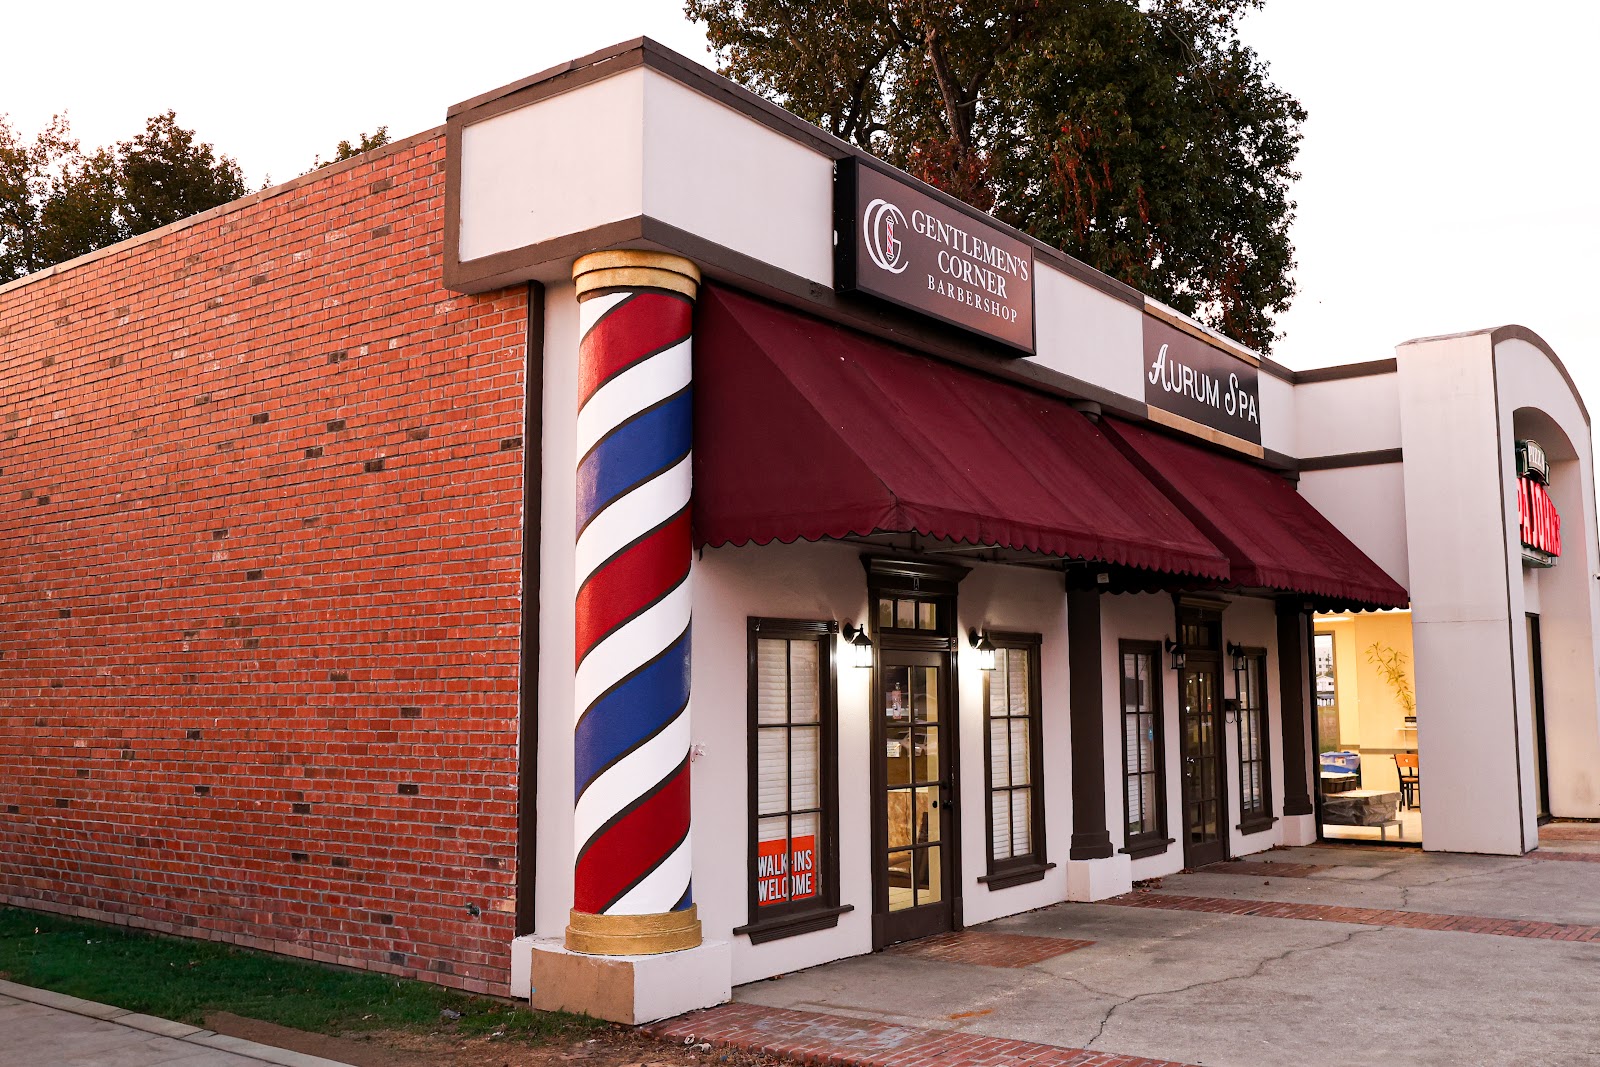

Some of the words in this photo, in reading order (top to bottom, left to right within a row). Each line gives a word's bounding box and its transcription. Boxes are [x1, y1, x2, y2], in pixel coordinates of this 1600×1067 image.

[911, 209, 1029, 281] GENTLEMEN'S
[937, 250, 1008, 298] CORNER
[927, 274, 1018, 323] BARBERSHOP
[1528, 445, 1545, 471] PIZZA
